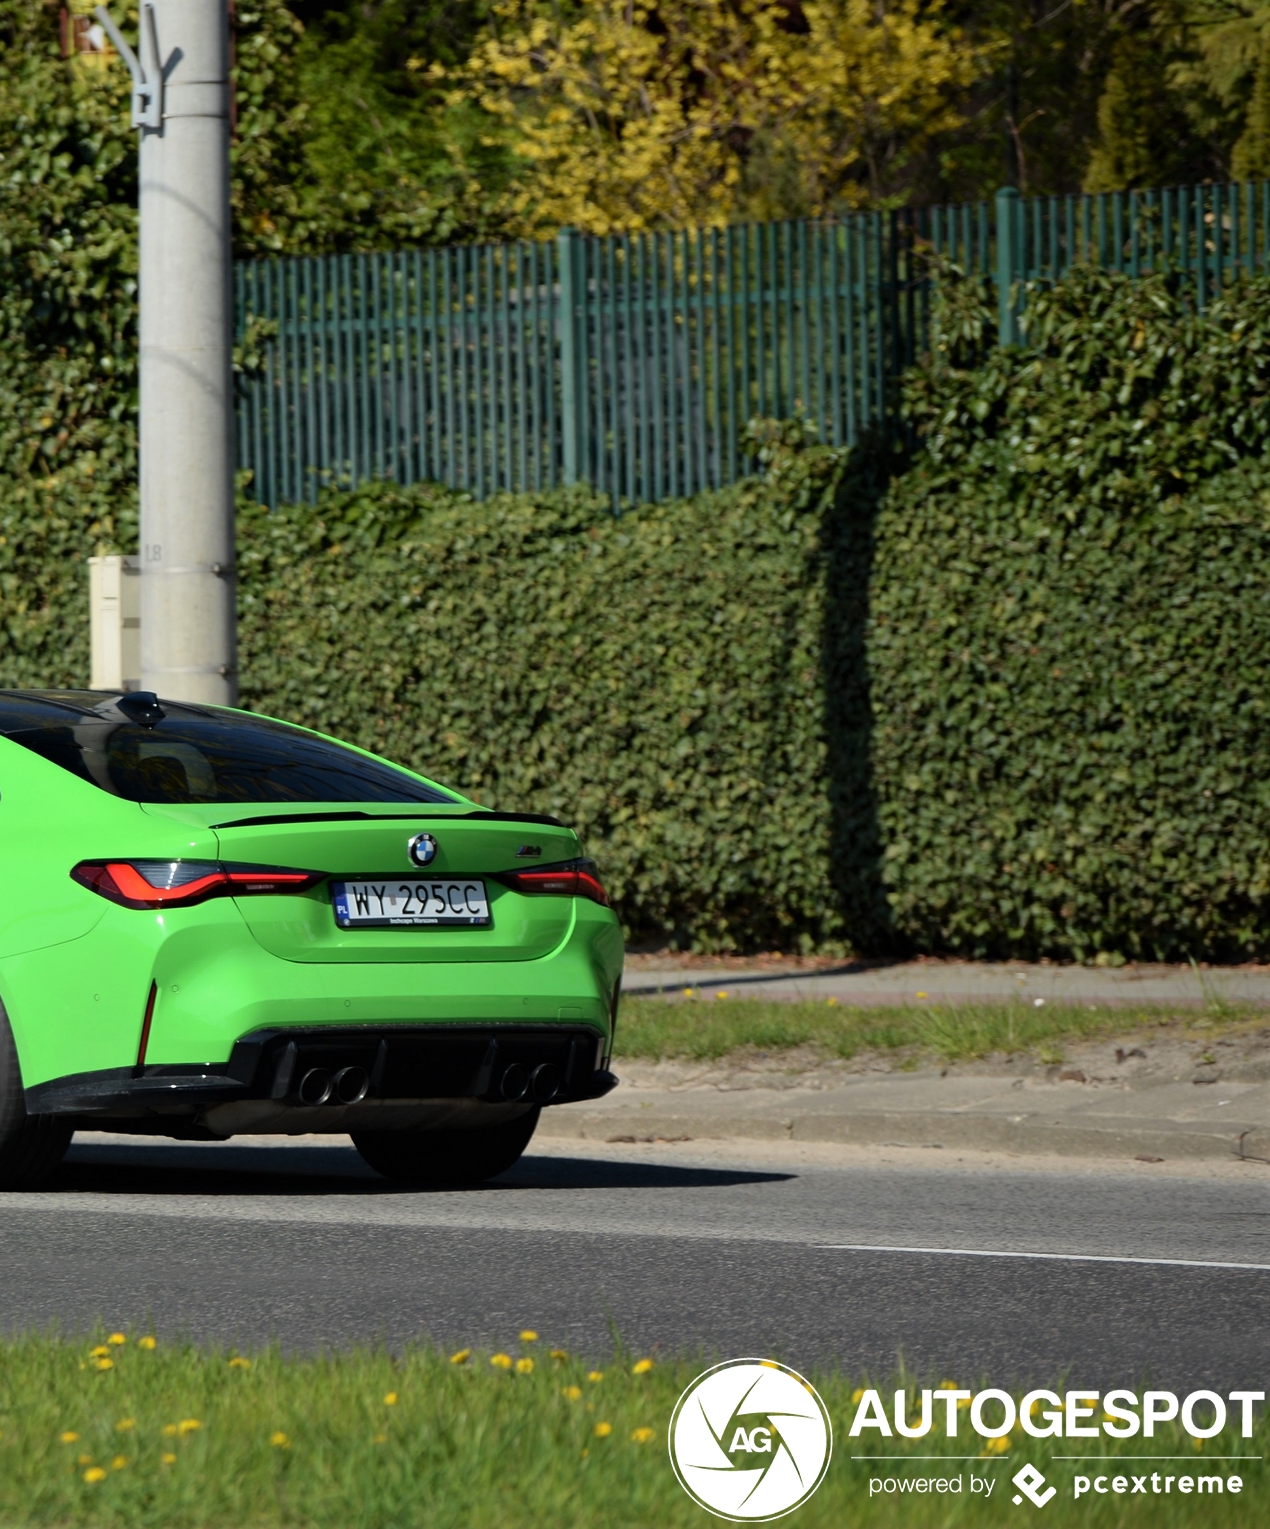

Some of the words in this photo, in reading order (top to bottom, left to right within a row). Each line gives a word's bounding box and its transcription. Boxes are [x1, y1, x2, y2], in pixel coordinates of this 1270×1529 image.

[337, 906, 348, 914] PL
[353, 885, 386, 916] WY
[398, 884, 481, 915] 295CC
